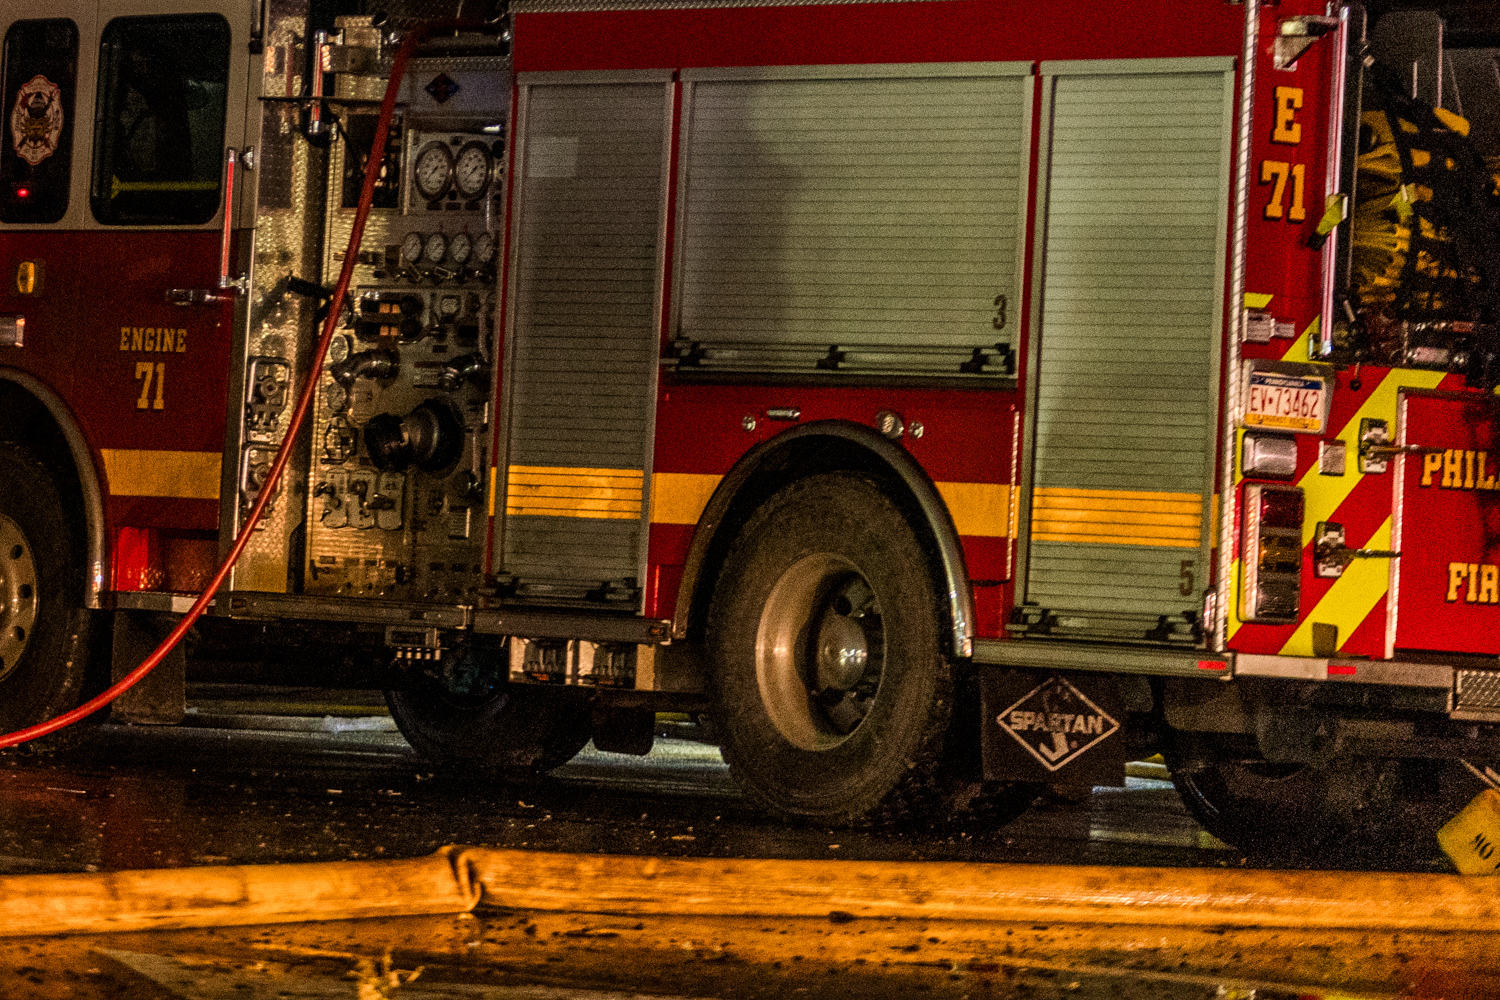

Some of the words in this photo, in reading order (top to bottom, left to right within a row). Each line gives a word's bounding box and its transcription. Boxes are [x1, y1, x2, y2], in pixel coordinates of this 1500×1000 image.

[1272, 86, 1304, 144] E
[1260, 160, 1306, 222] 71
[993, 294, 1007, 330] 3
[120, 326, 188, 353] ENGINE
[135, 361, 166, 411] 71
[1180, 560, 1194, 597] 5
[1010, 710, 1103, 735] SPARTAN
